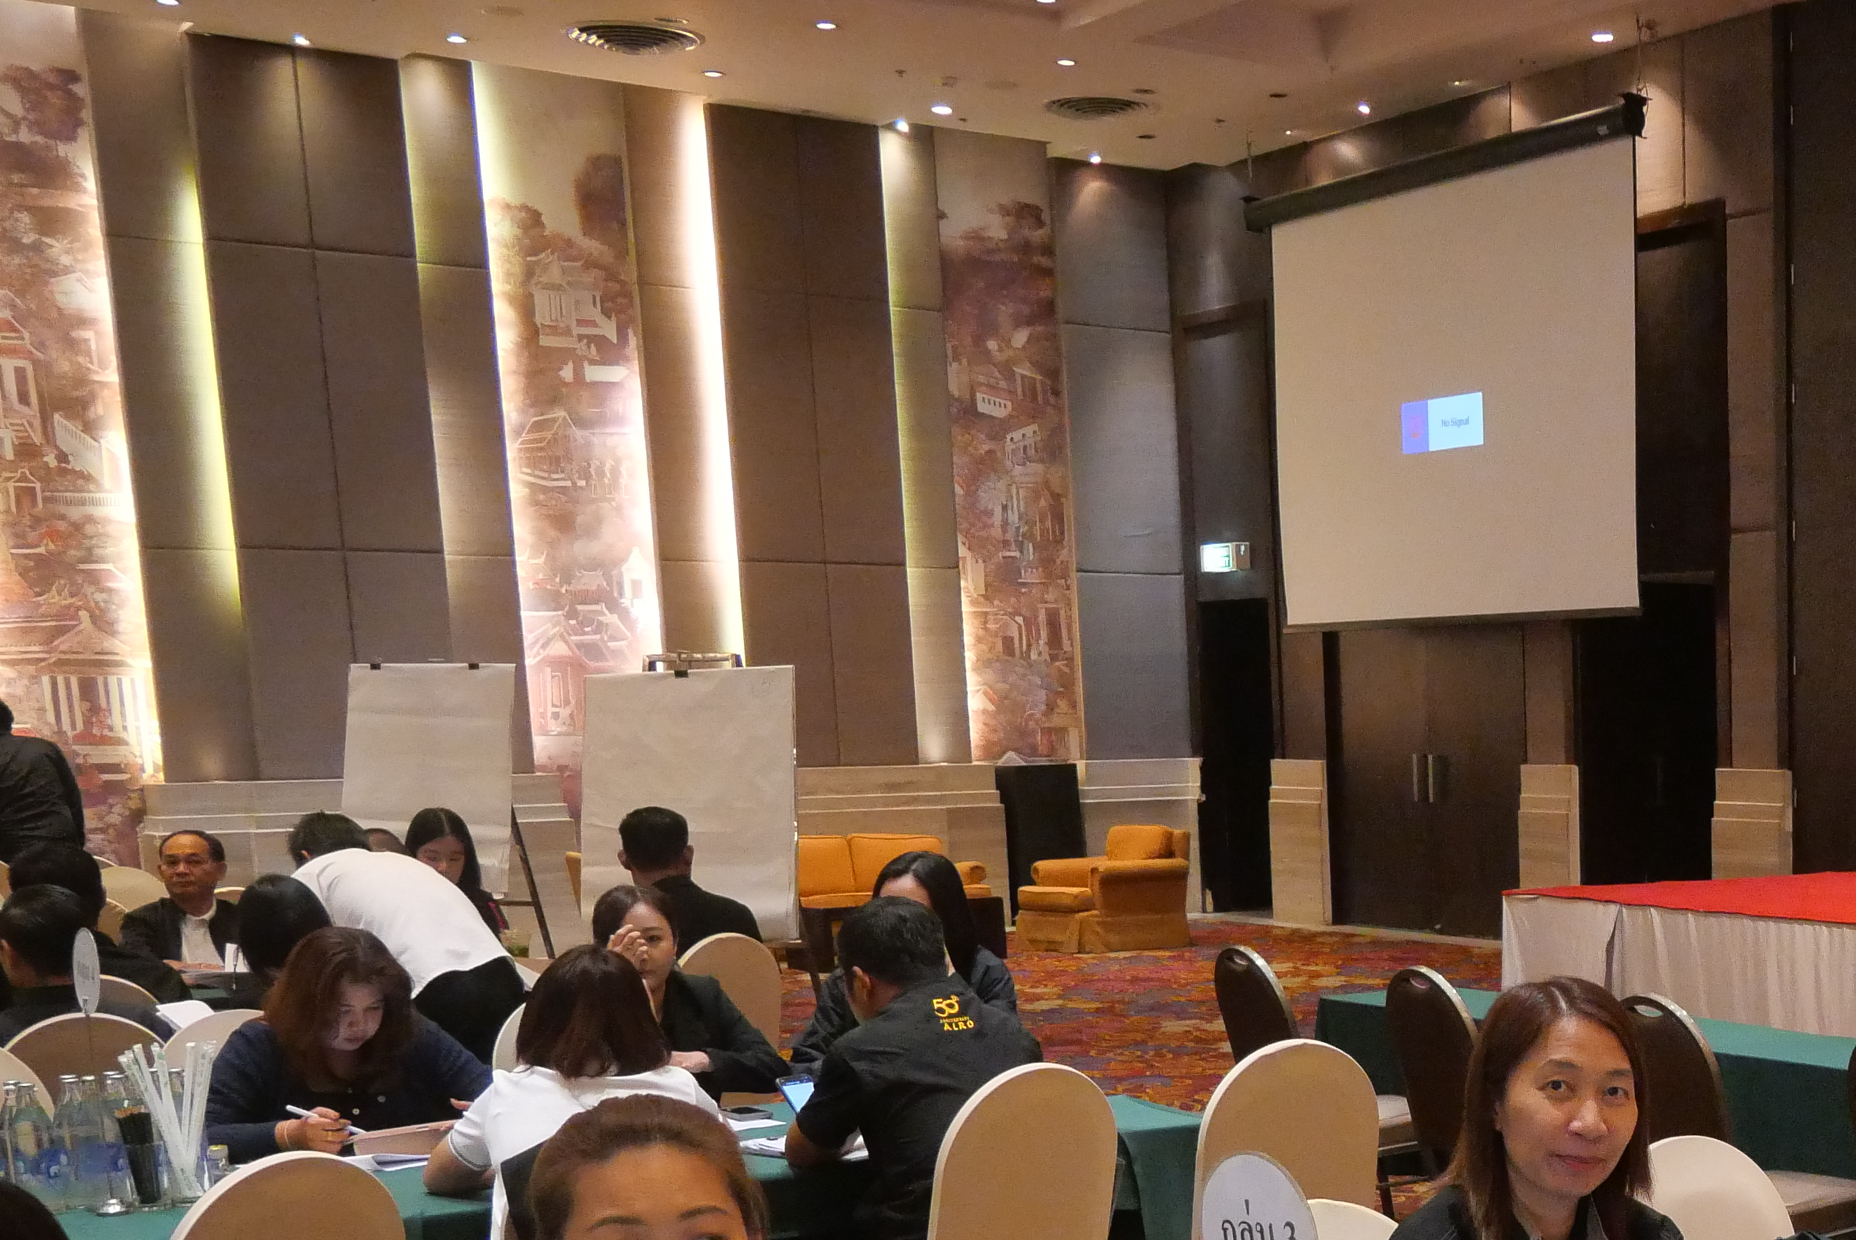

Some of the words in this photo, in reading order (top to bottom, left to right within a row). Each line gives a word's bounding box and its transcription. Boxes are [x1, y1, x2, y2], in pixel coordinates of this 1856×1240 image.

[1441, 419, 1450, 427] No
[1451, 416, 1470, 428] Signal
[944, 1020, 975, 1031] ALRO
